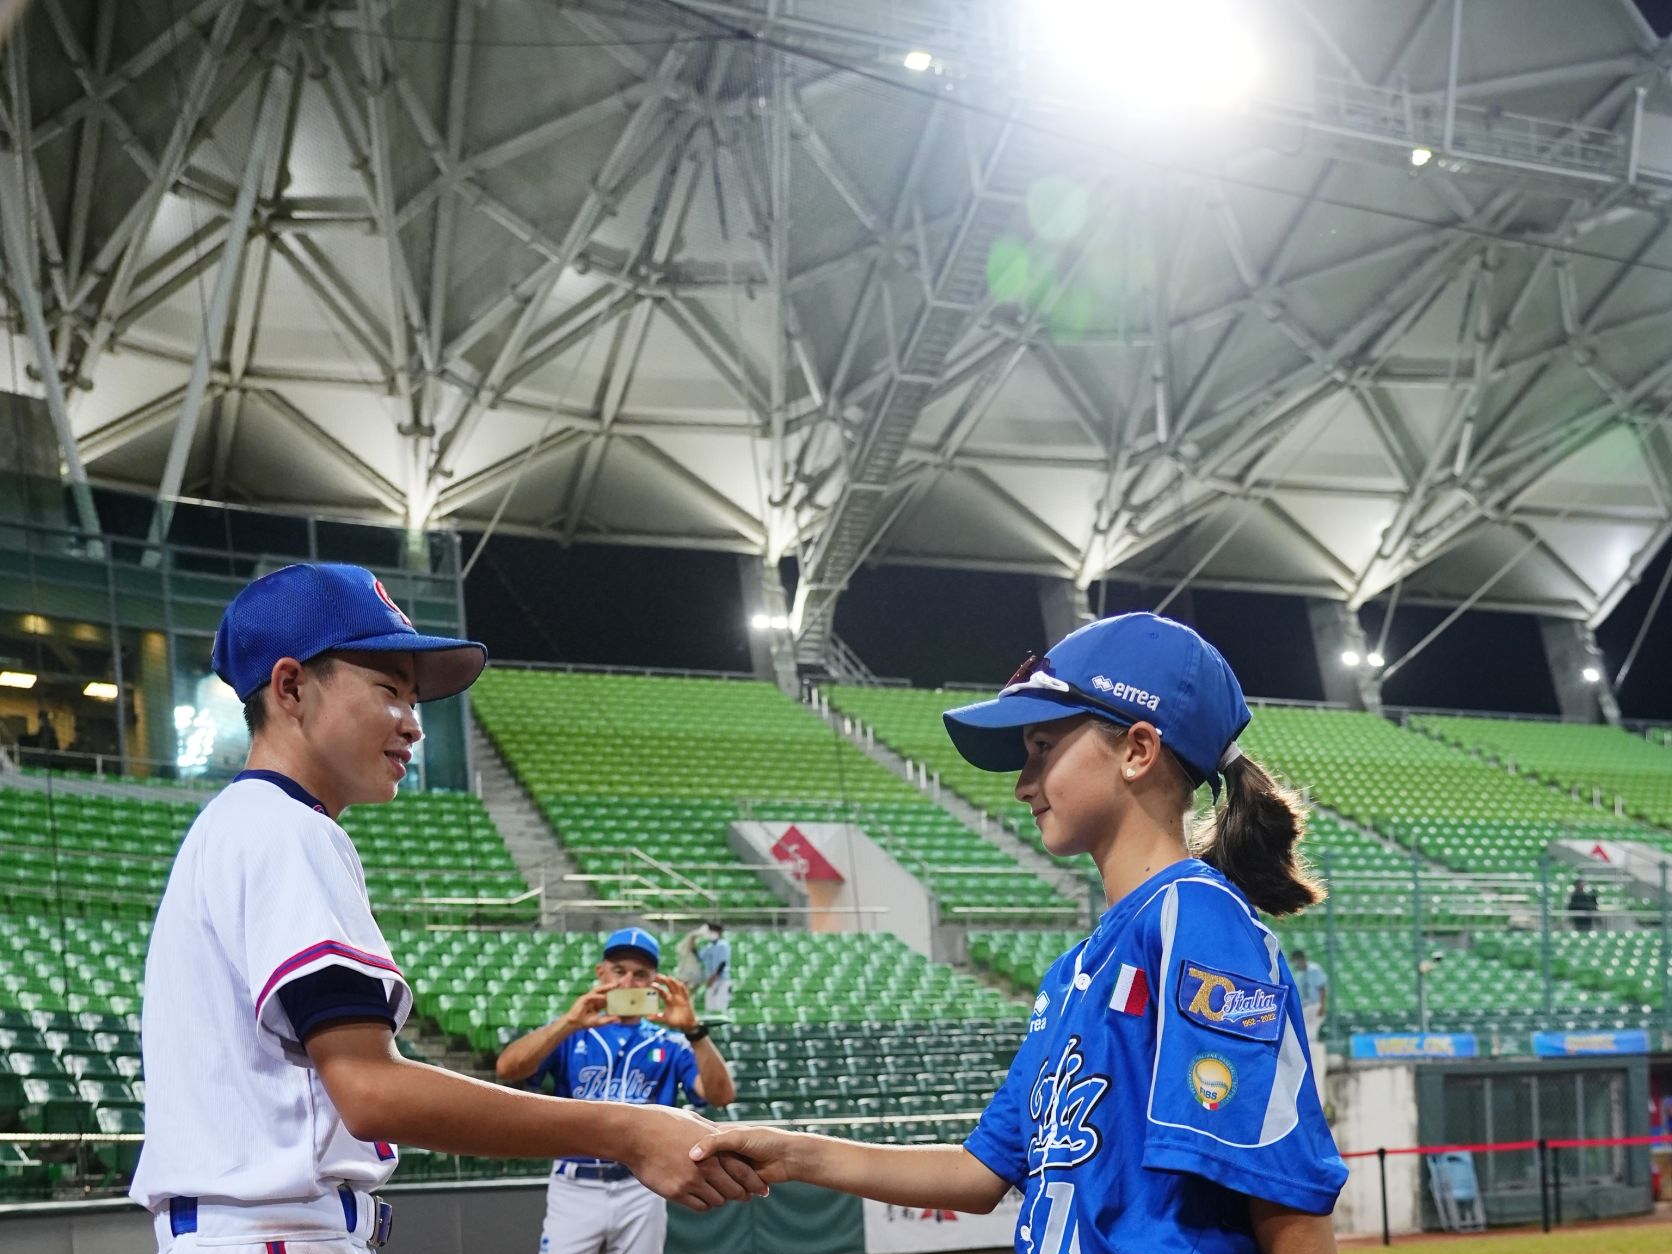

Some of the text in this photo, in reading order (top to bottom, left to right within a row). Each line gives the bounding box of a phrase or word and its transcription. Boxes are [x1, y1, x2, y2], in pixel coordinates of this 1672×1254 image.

[1112, 682, 1161, 712] errea
[1188, 967, 1277, 1022] 70 Italia
[1029, 1016, 1047, 1033] rea
[572, 1065, 658, 1101] Italia
[1201, 1086, 1218, 1101] FIBS
